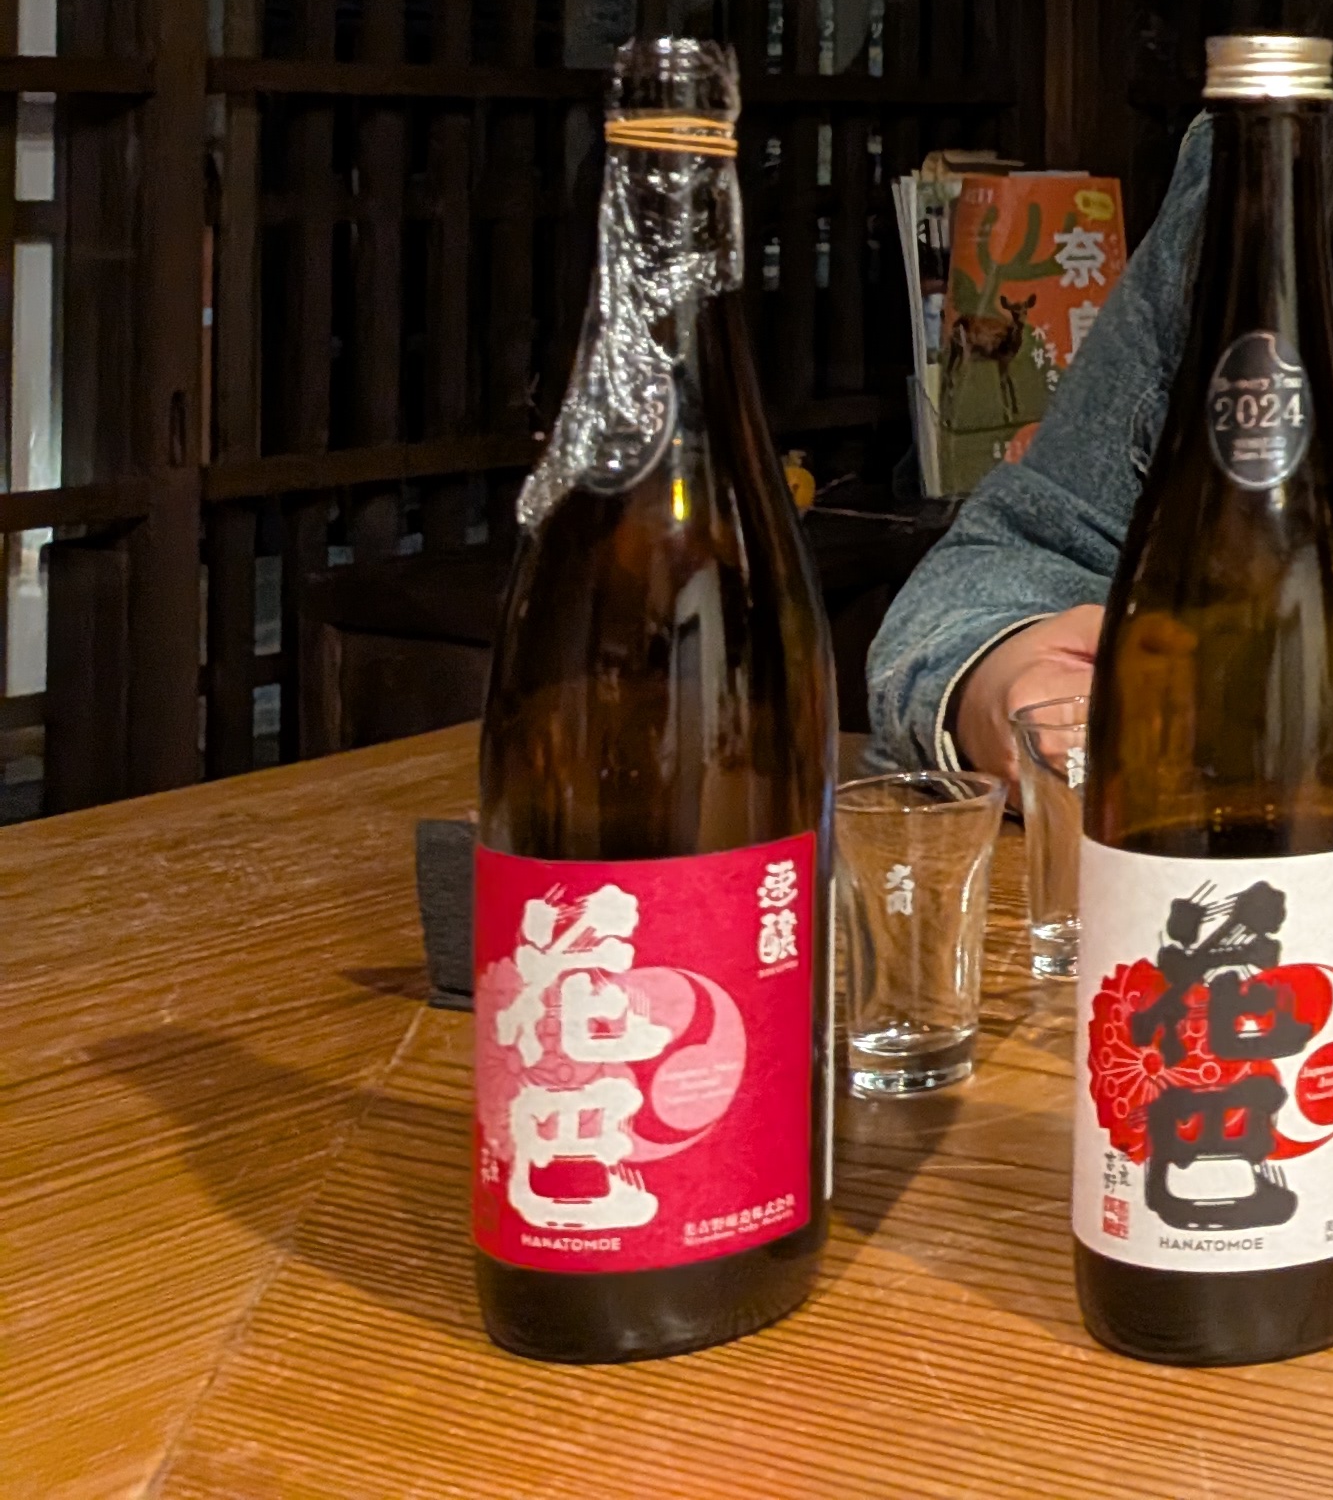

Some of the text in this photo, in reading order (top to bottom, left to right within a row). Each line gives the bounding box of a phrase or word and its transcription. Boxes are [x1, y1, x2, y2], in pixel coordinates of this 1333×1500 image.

[1214, 393, 1304, 431] 2024
[520, 1234, 621, 1252] HANATOMOE
[1159, 1237, 1263, 1252] HANATOMOE
